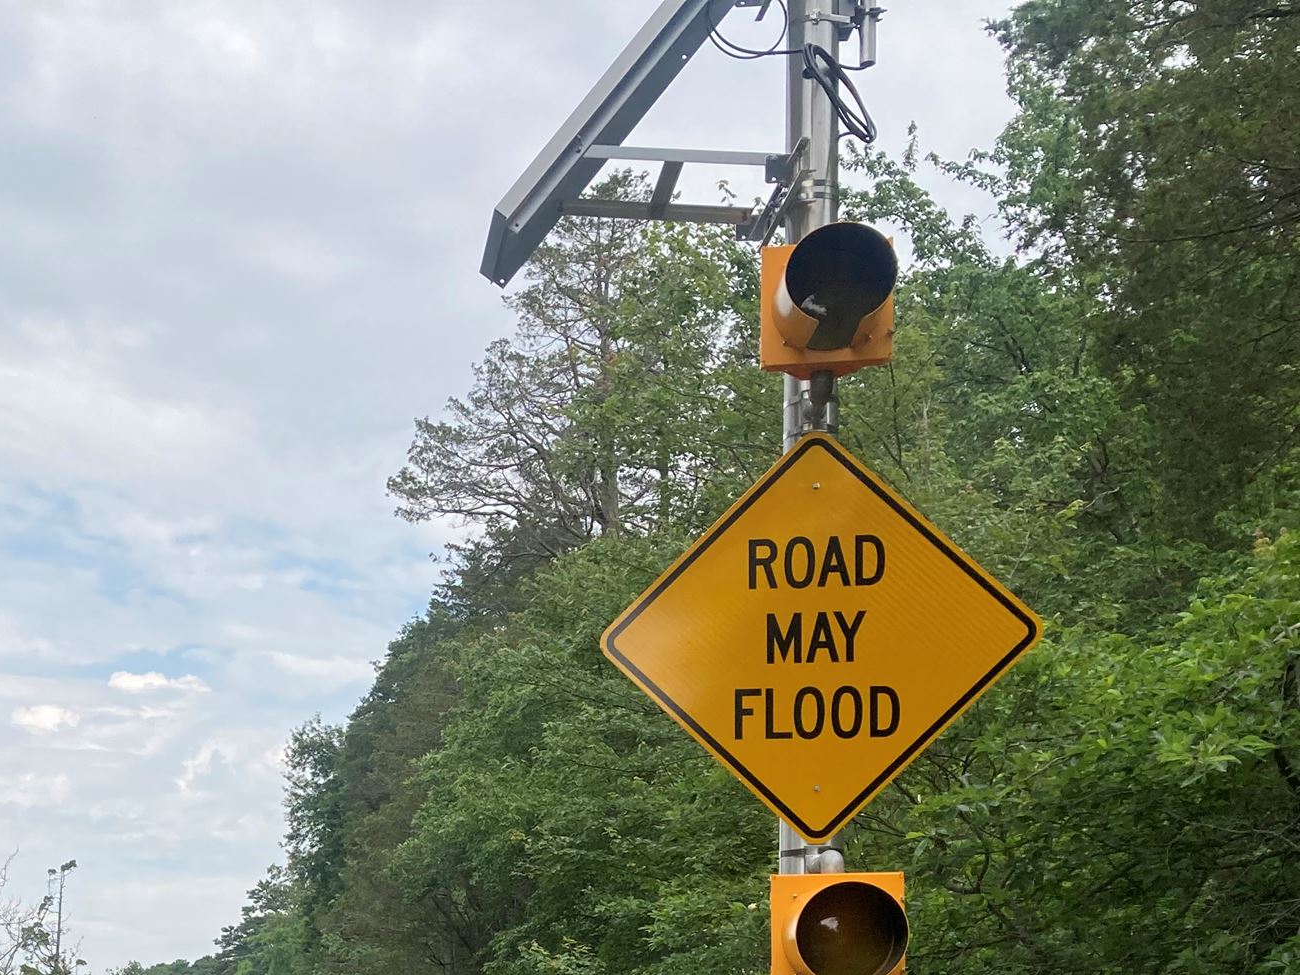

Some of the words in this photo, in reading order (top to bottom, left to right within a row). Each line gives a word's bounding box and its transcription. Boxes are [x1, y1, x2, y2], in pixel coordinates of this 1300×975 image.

[748, 535, 885, 589] ROAD
[766, 611, 866, 664] MAY
[734, 685, 900, 740] FLOOD
